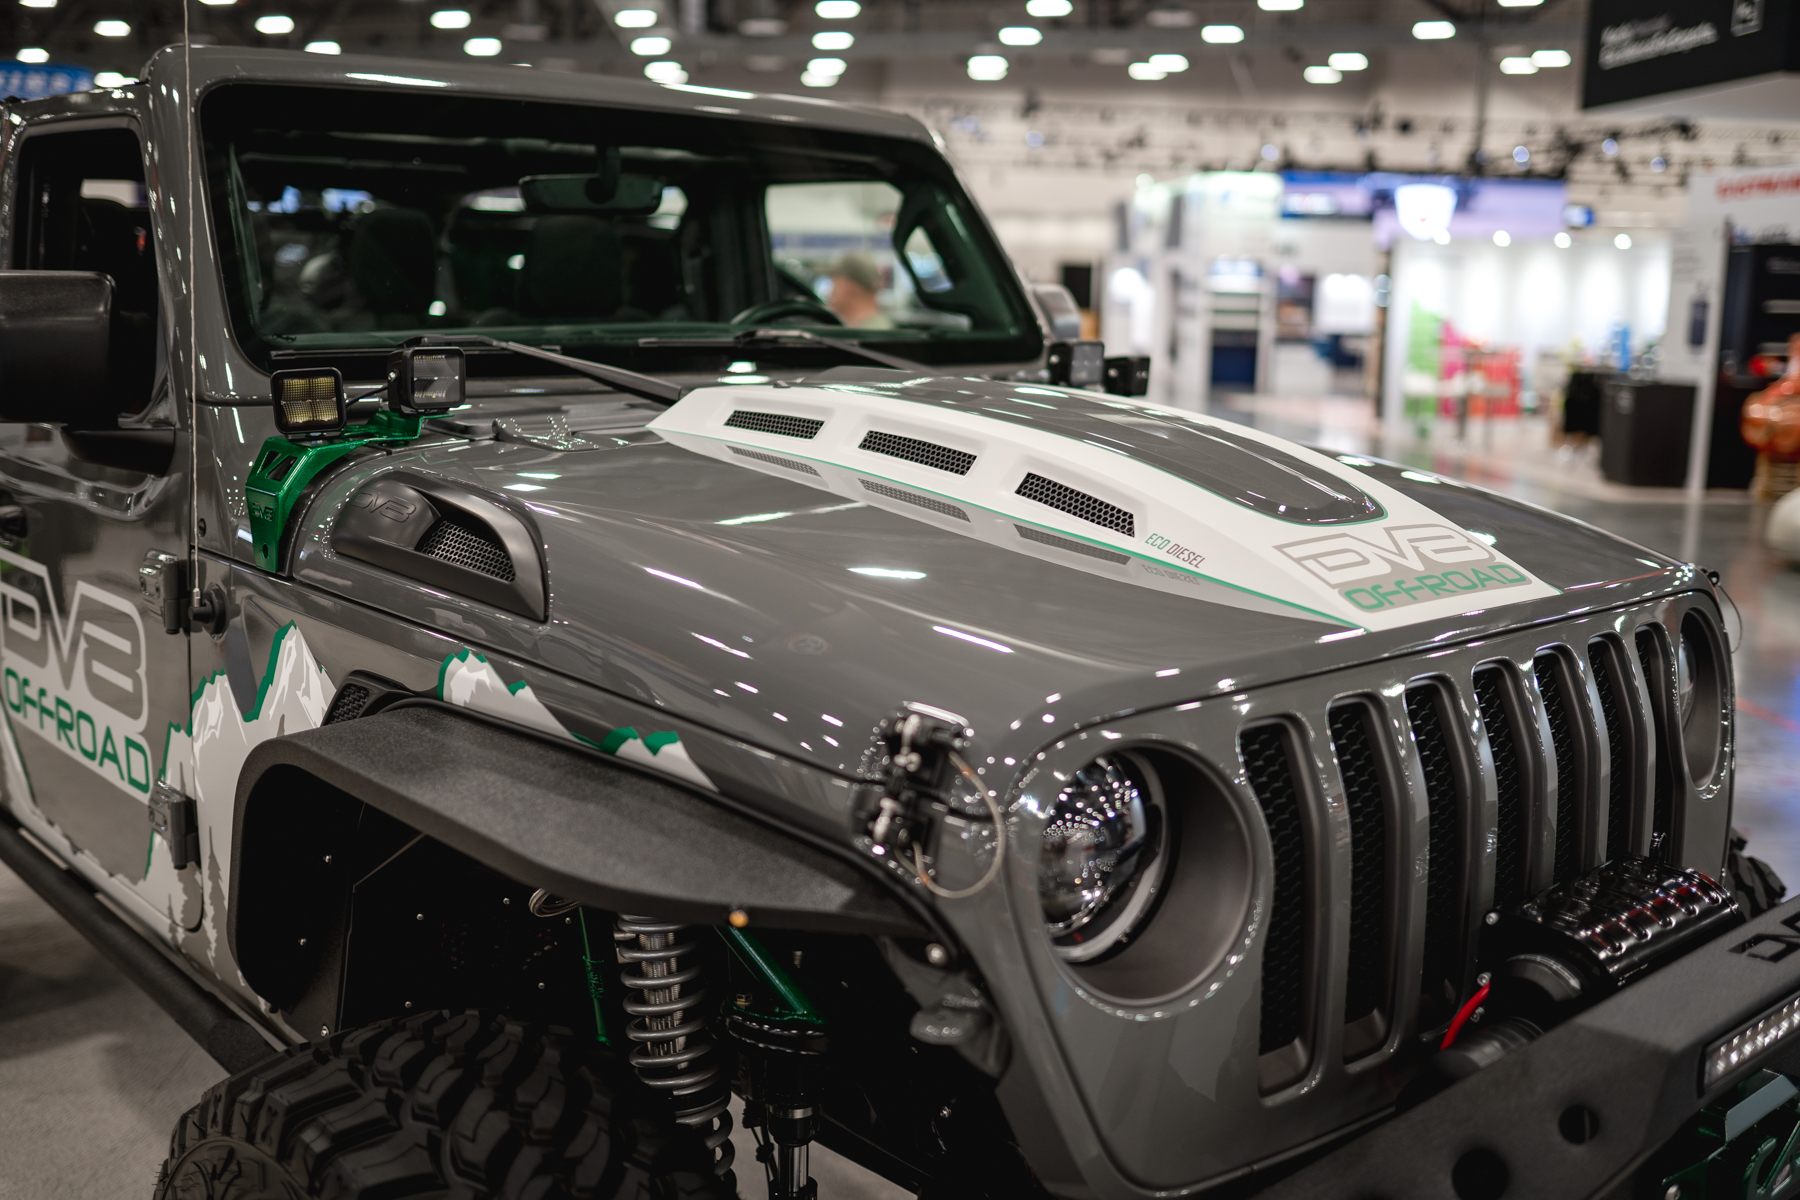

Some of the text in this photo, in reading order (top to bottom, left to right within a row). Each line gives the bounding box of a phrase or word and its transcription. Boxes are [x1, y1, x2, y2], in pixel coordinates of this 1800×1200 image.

[1145, 533, 1206, 569] ECO DIESEL
[1272, 523, 1497, 589] DV8
